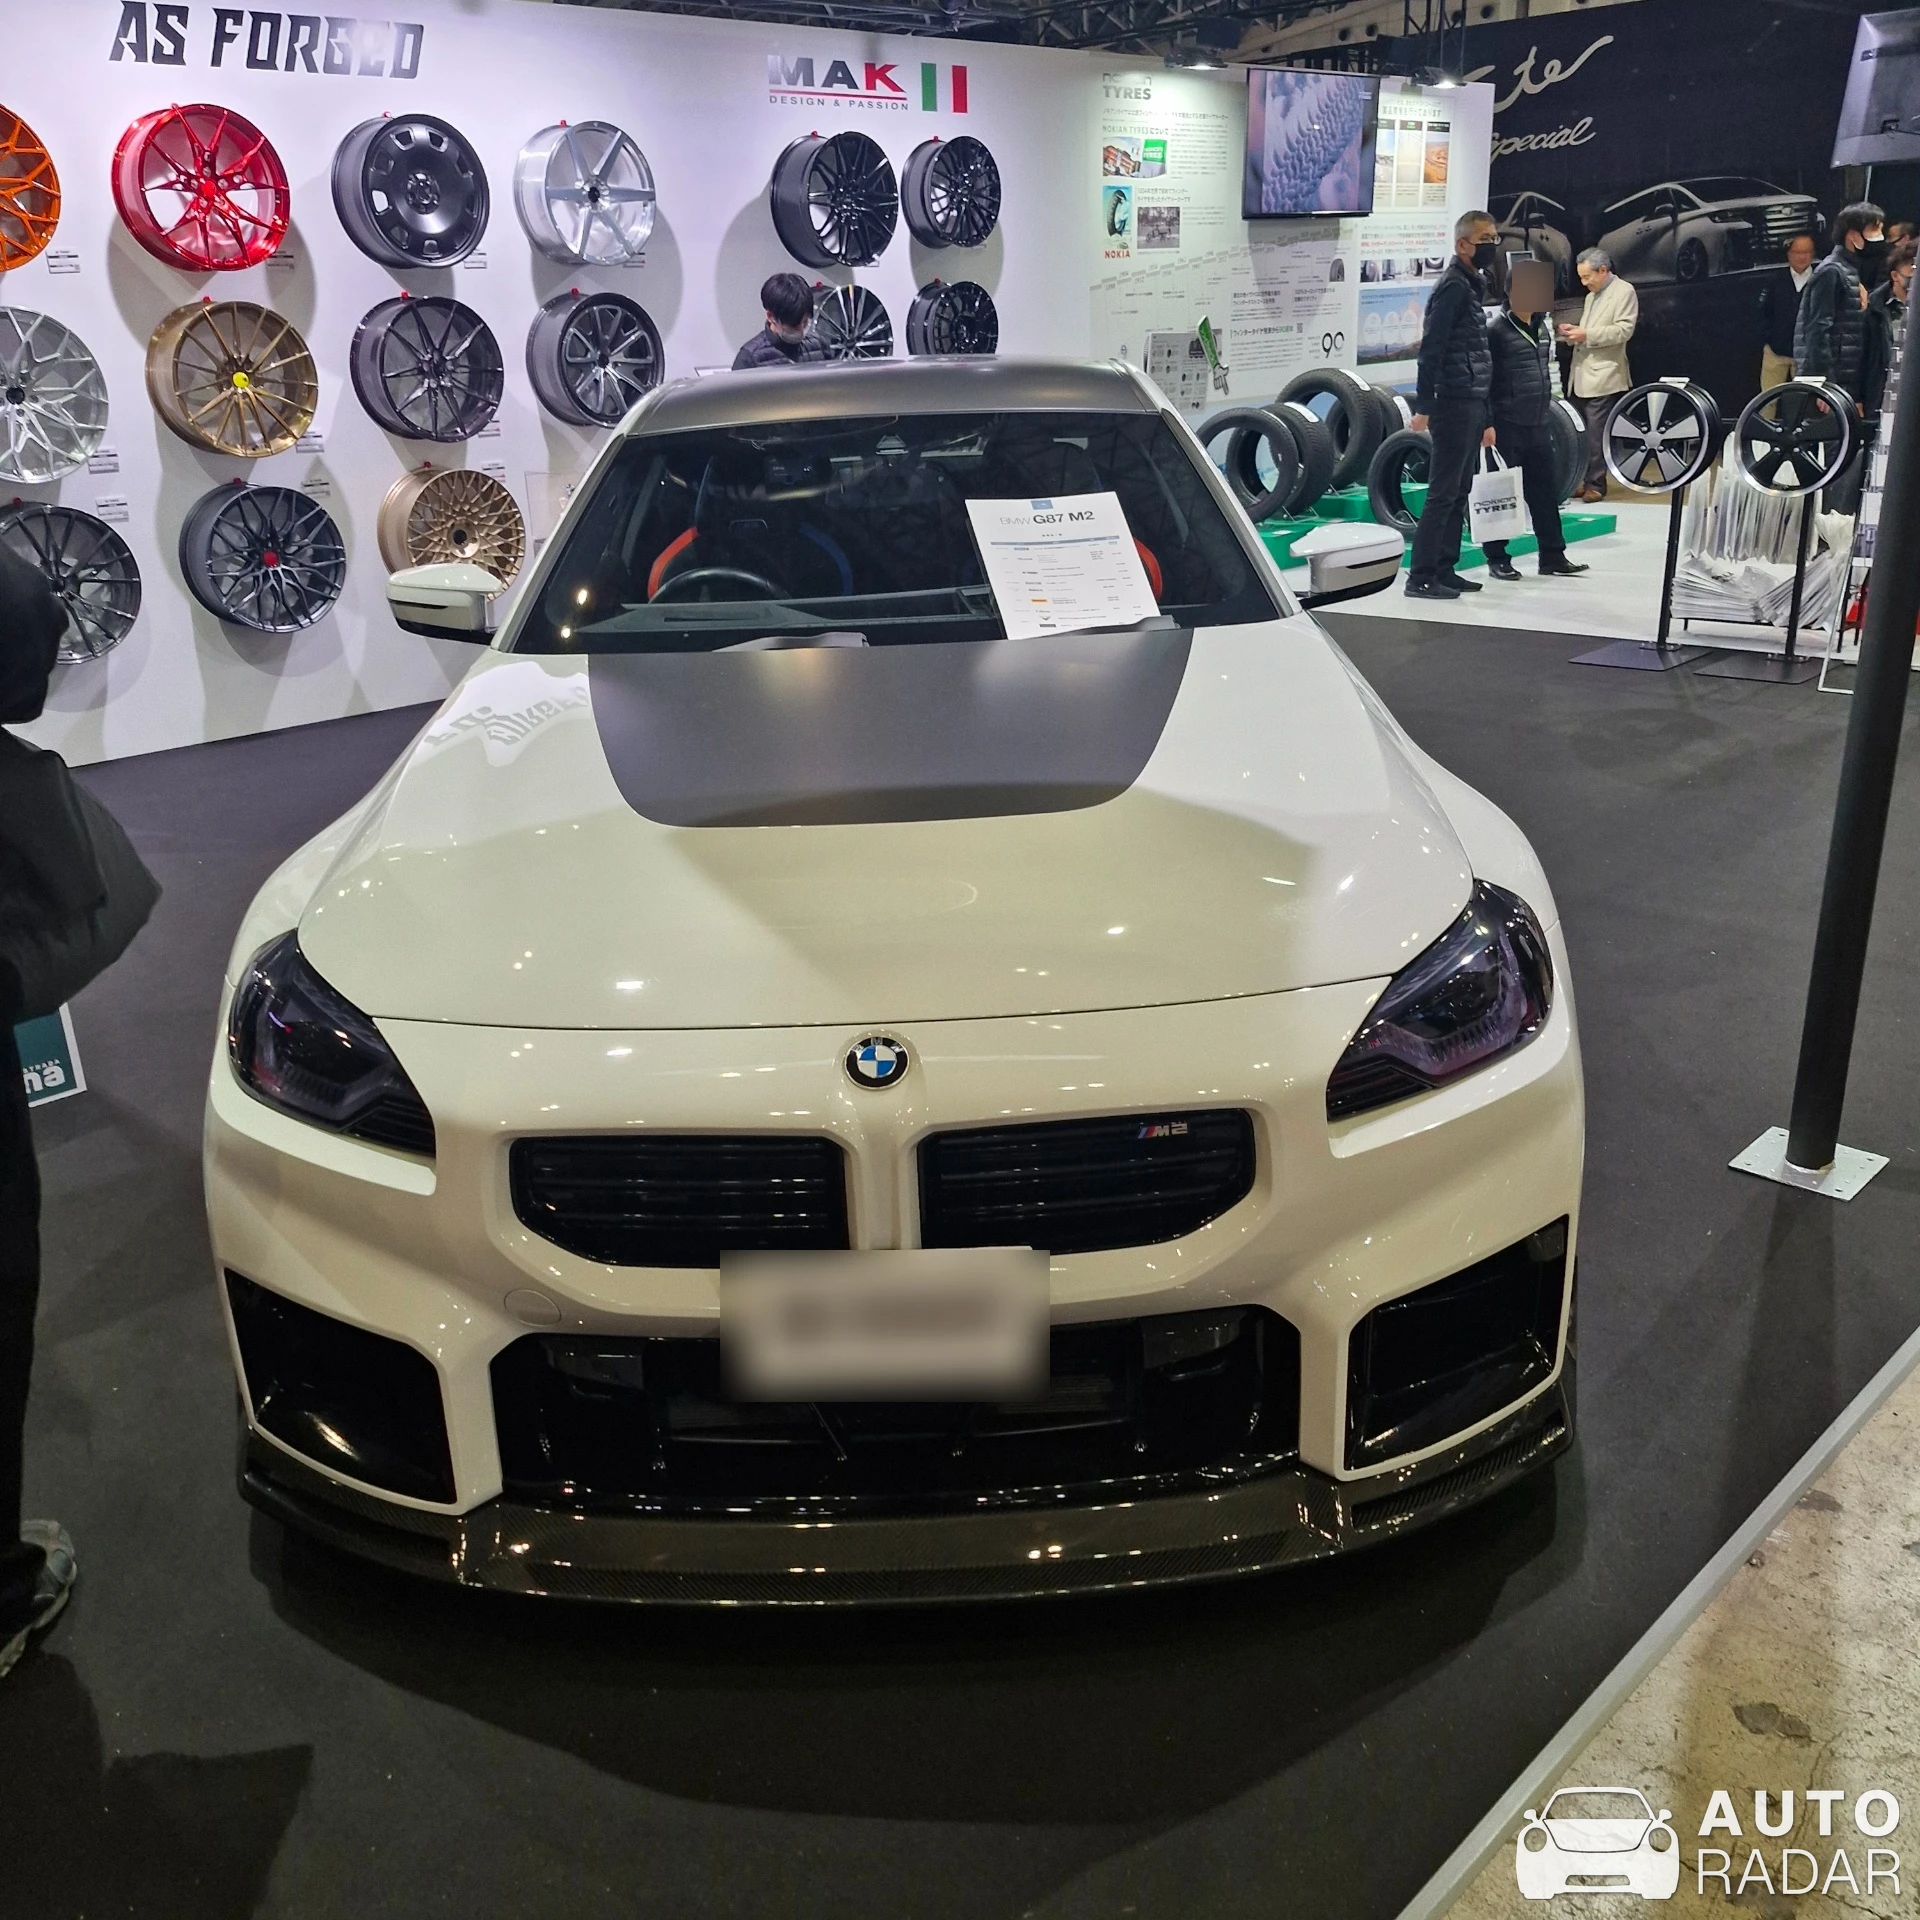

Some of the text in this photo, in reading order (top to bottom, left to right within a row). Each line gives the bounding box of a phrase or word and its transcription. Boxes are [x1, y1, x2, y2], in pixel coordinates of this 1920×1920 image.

[109, 0, 424, 79] AS FORGED
[767, 54, 906, 93] MAK
[1102, 85, 1152, 101] TYRES
[769, 95, 909, 111] DESIGN & PASSION
[1104, 250, 1131, 259] NOKIA
[1474, 502, 1517, 515] TYRES
[1000, 510, 1095, 525] BMW G87 M2
